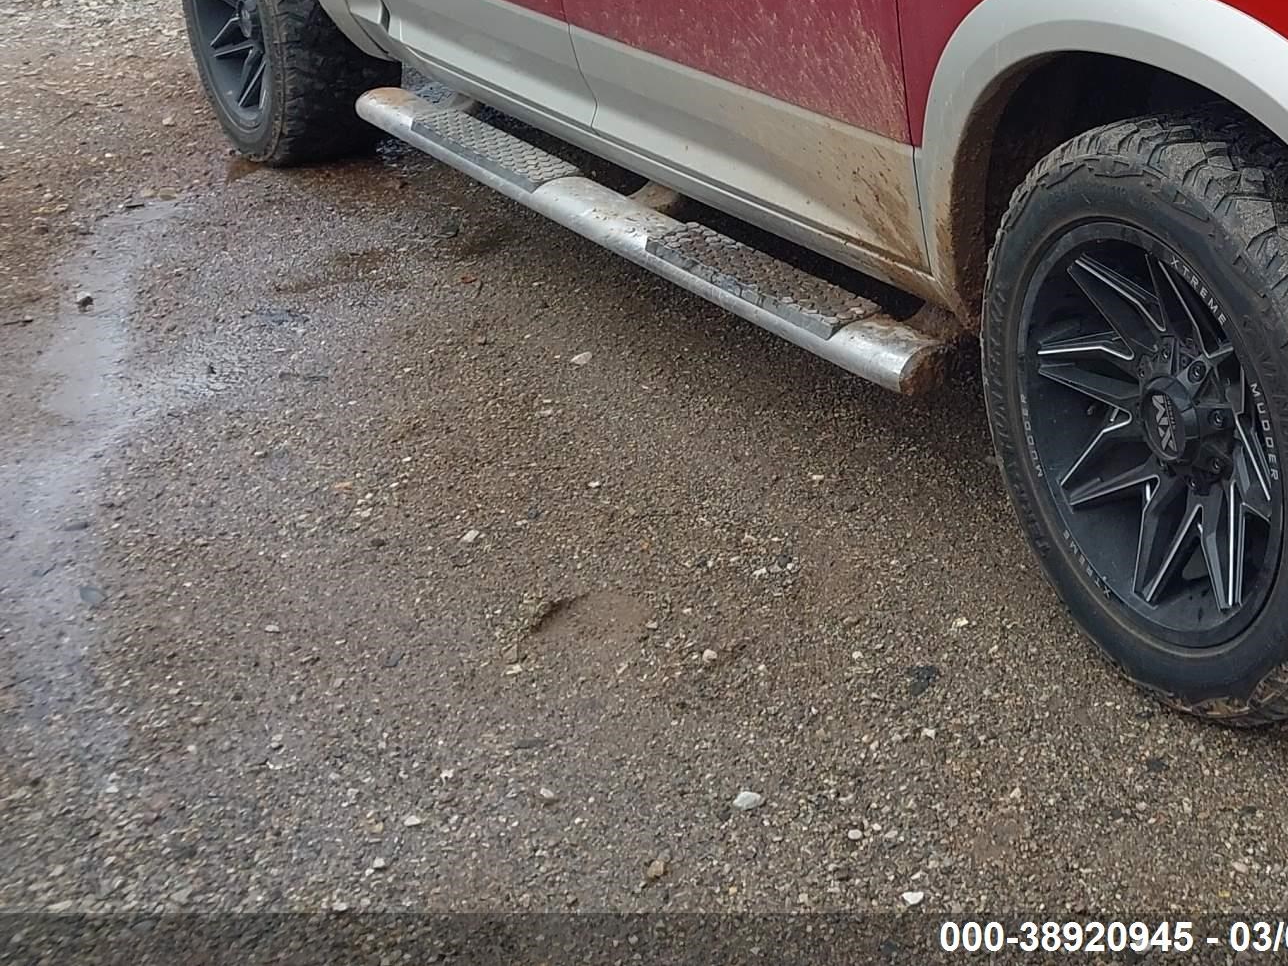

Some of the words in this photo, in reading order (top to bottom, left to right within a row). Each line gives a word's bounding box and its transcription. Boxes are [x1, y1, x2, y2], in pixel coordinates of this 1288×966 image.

[1170, 255, 1227, 326] XTREME
[1020, 394, 1044, 478] MUDDER
[1249, 383, 1280, 480] MUDDER
